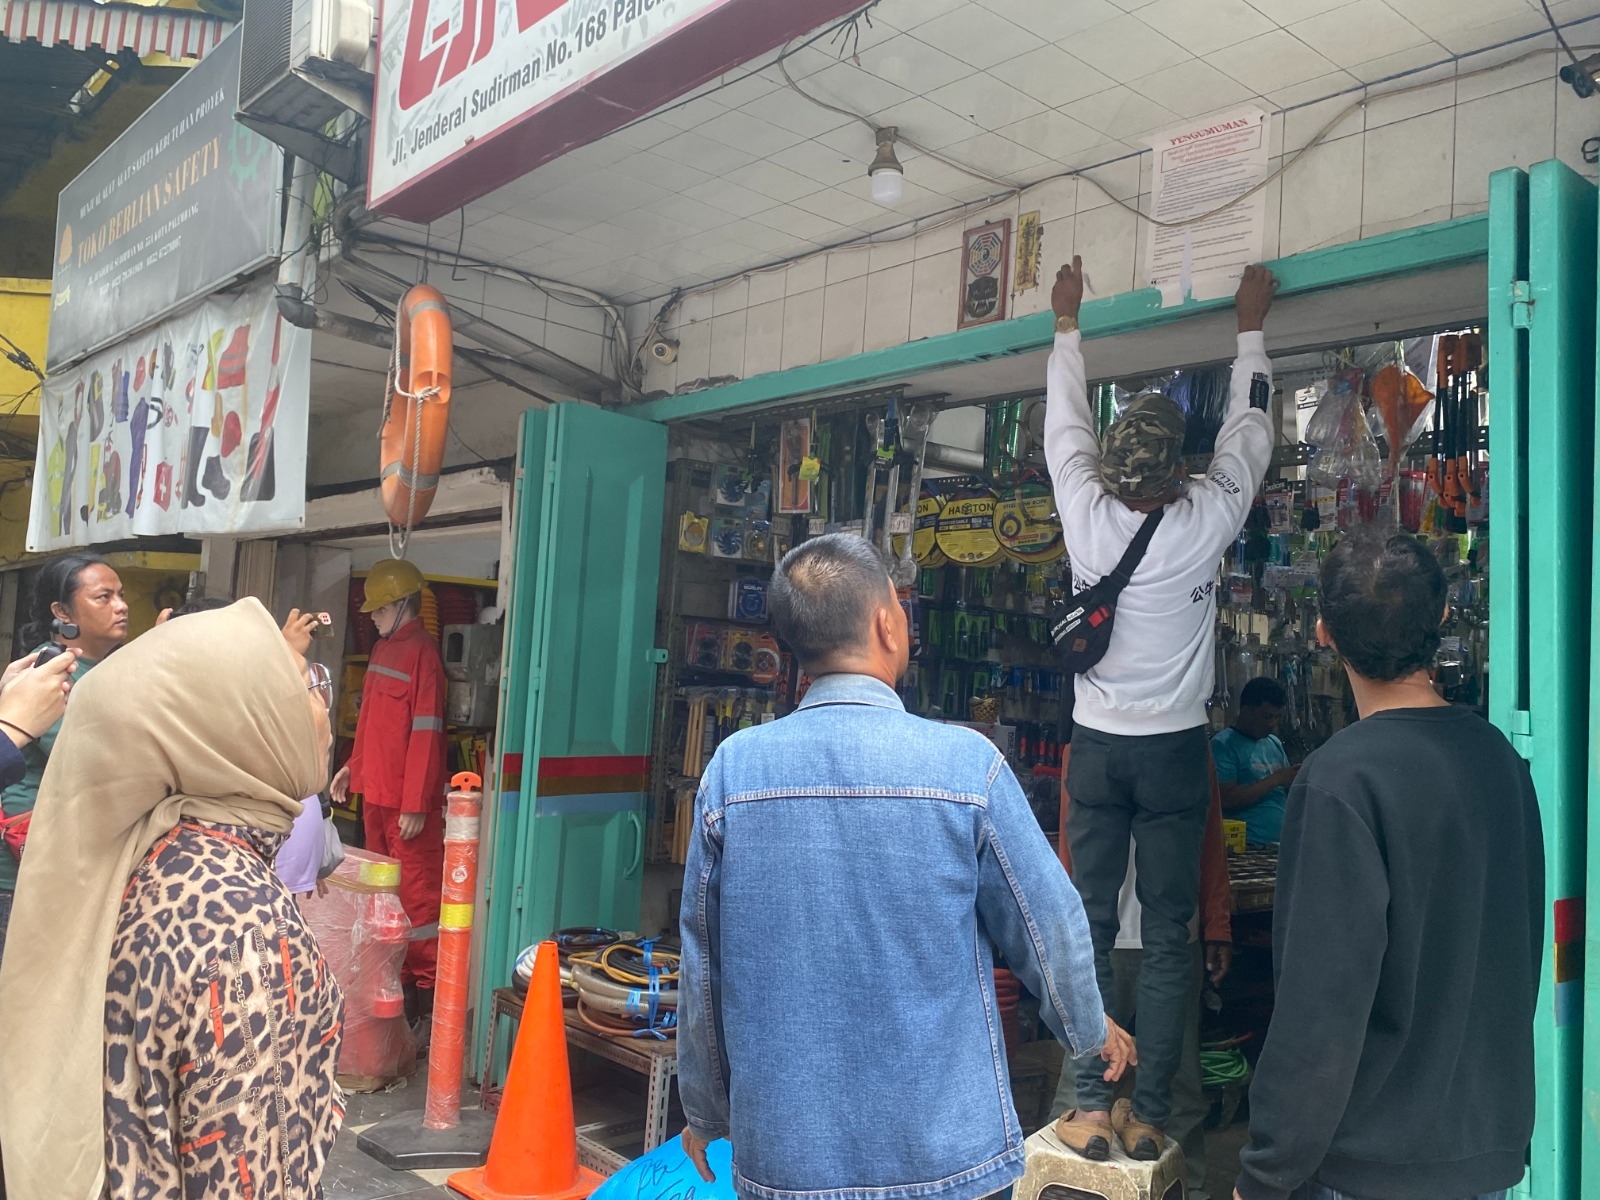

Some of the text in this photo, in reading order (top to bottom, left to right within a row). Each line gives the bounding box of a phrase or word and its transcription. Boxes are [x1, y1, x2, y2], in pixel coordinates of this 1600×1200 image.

[131, 148, 154, 175] SAFETY
[195, 87, 226, 122] PROYEK
[393, 138, 406, 166] Jl.
[411, 99, 466, 155] Jenderal
[471, 57, 541, 115] Sudirman
[546, 38, 571, 73] No.
[575, 15, 606, 53] 168
[1170, 118, 1249, 146] PENGUMUMAN
[77, 224, 106, 269] TOKO
[108, 180, 163, 246] BERLIAN
[163, 133, 222, 205] SAFETY
[168, 201, 200, 233] PALEMBANG
